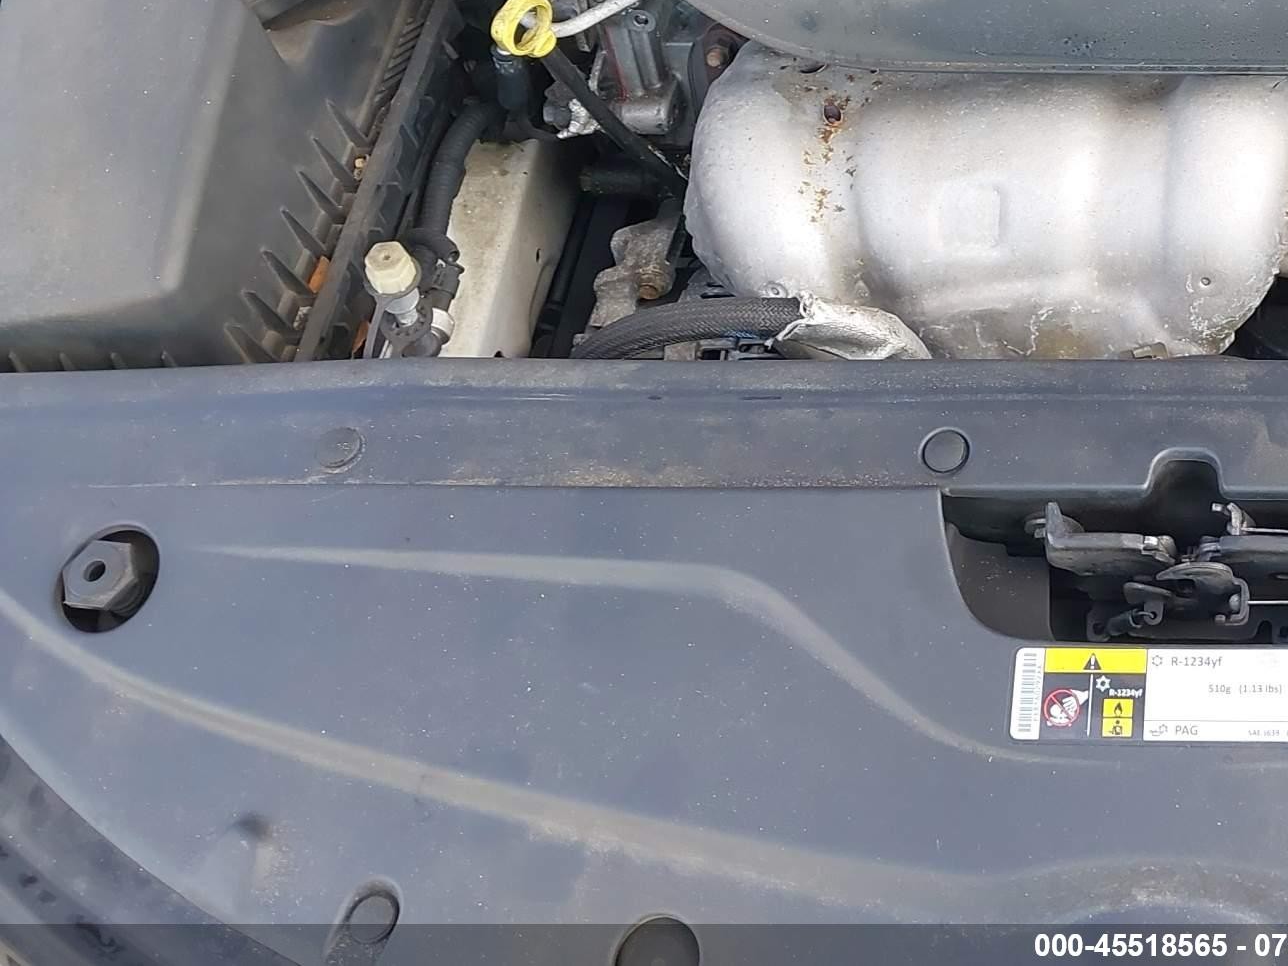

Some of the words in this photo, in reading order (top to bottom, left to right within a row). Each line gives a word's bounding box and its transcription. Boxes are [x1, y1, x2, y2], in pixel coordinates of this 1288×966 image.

[1171, 656, 1223, 668] R-1234yf
[1109, 688, 1143, 699] R-1234yf
[1208, 684, 1232, 695] 510g
[1175, 725, 1199, 736] PAG
